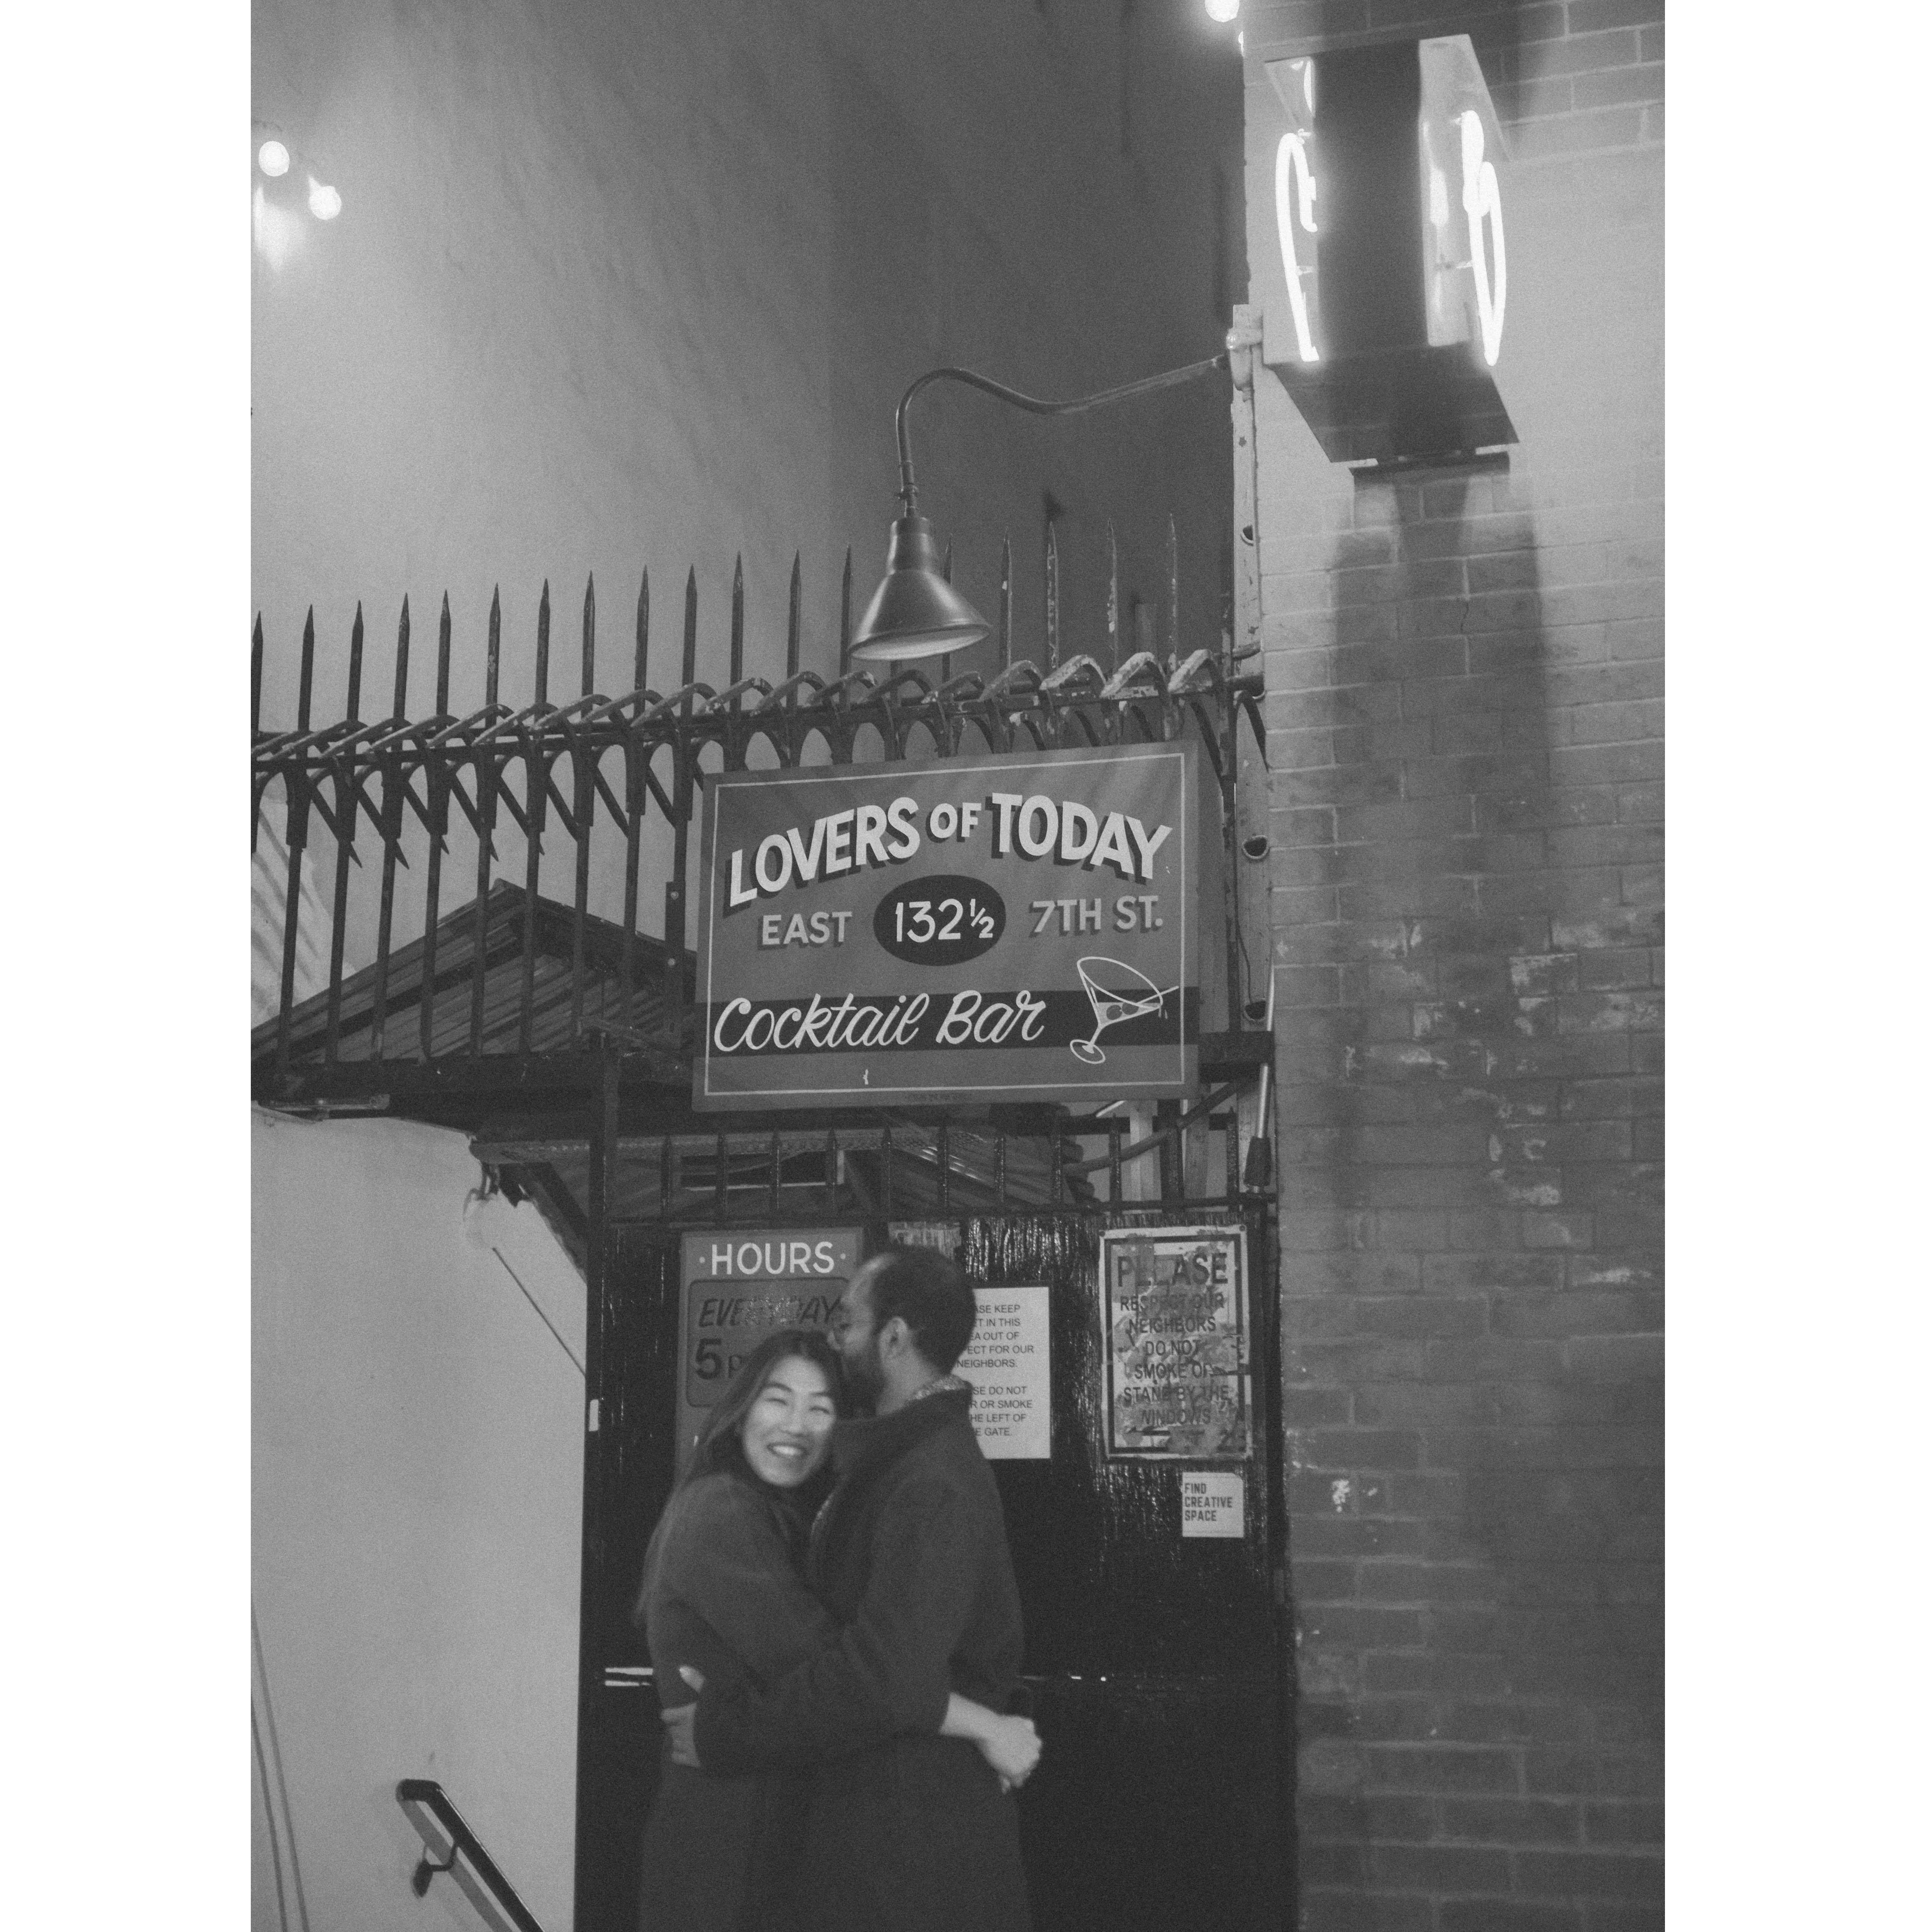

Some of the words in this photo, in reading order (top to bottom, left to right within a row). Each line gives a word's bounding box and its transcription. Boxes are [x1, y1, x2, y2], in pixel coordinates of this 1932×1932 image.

[730, 797, 920, 907] LOVERS
[930, 802, 981, 839] OF
[992, 792, 1173, 879] TODAY
[761, 911, 852, 945] EAST
[1032, 897, 1102, 933] 7TH
[1116, 895, 1163, 930] ST.
[713, 992, 930, 1052] Cocktail
[935, 989, 1047, 1045] Bar
[712, 1241, 834, 1275] HOURS
[698, 1296, 842, 1328] EVEAY
[995, 1305, 1020, 1313] KEEP
[986, 1319, 996, 1327] IN
[999, 1318, 1020, 1327] THIS
[1129, 1316, 1216, 1333] NEIGHBORS
[983, 1332, 1004, 1341] OUT
[1007, 1332, 1019, 1340] OF
[967, 1346, 986, 1354] ECT
[989, 1345, 1010, 1354] FOR
[1013, 1345, 1034, 1353] OUR
[1146, 1341, 1166, 1356] DO
[957, 1359, 1018, 1368] NEIGHBORS.
[1135, 1363, 1187, 1379] SMOKE
[973, 1386, 985, 1395] SE
[989, 1386, 1004, 1395] DO
[1006, 1386, 1027, 1394] NOT
[970, 1400, 978, 1408] R
[980, 1400, 995, 1408] OR
[998, 1400, 1033, 1408] SMOKE
[970, 1414, 983, 1422] HE
[986, 1414, 1010, 1422] LEFT
[1013, 1413, 1026, 1422] OF
[974, 1427, 981, 1436] E
[984, 1427, 1012, 1436] GATE.
[1185, 1483, 1206, 1494] FIND
[1185, 1496, 1232, 1508] CREATIVE
[1185, 1510, 1217, 1521] SPACE
